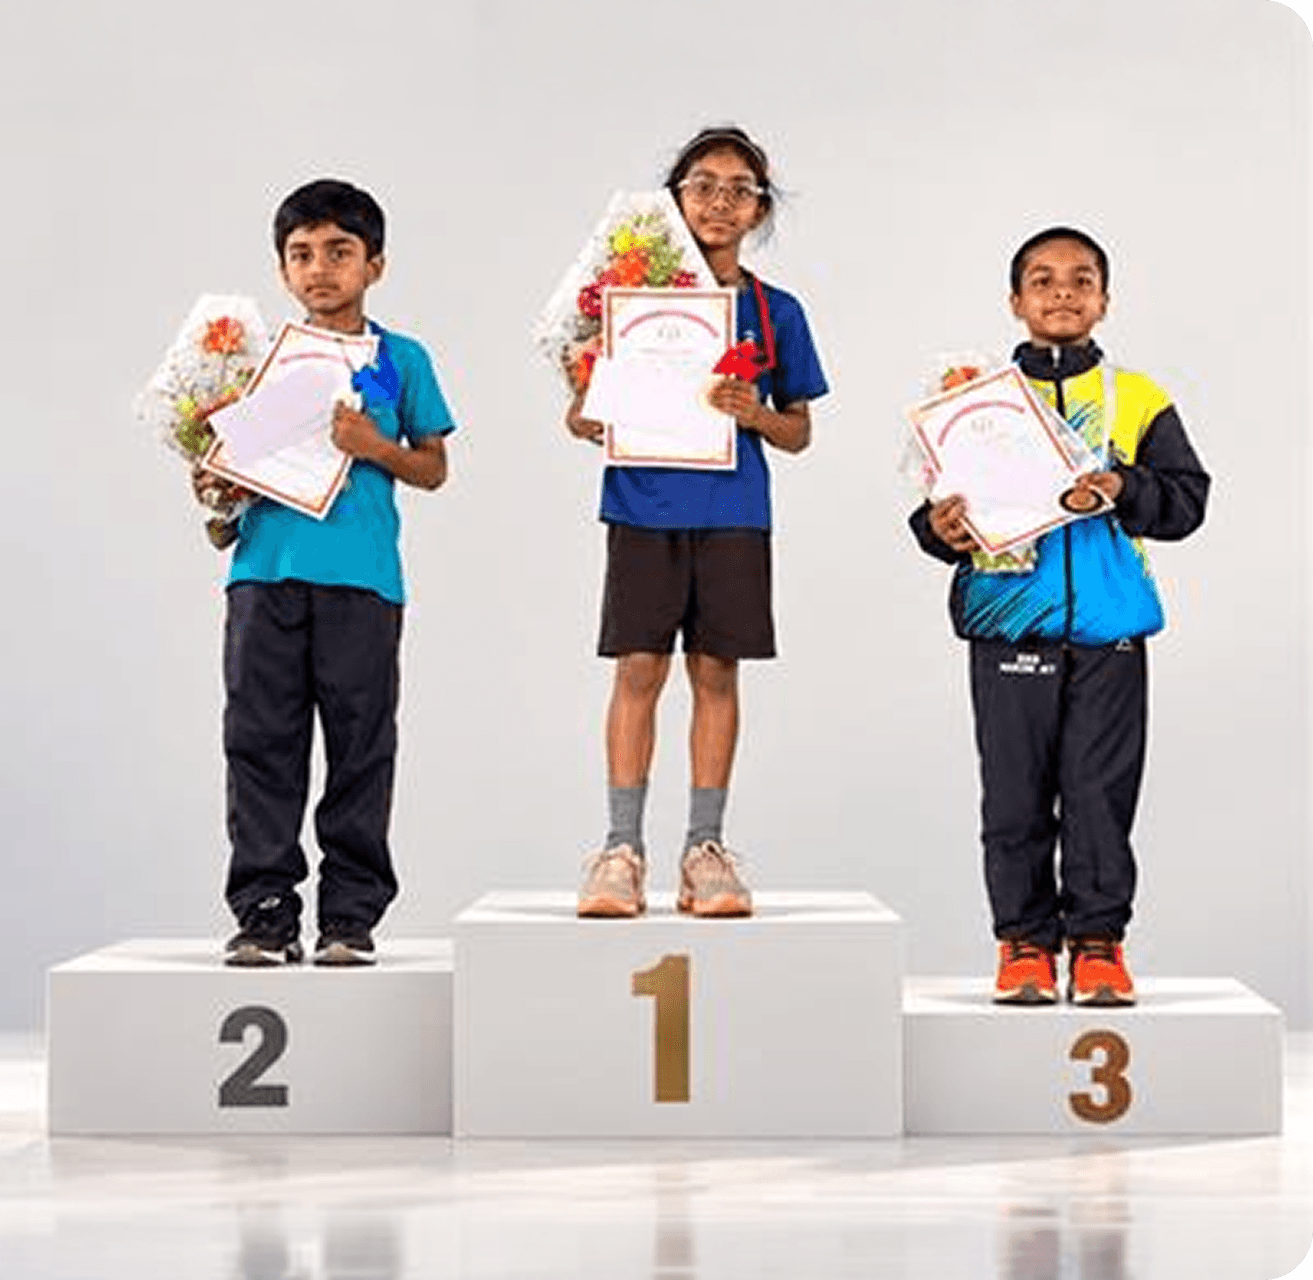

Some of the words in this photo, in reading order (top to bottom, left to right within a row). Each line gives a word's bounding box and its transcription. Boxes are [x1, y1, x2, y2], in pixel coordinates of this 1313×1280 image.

[217, 1005, 290, 1109] 2
[630, 954, 691, 1104] 1
[1067, 1029, 1133, 1125] 3
